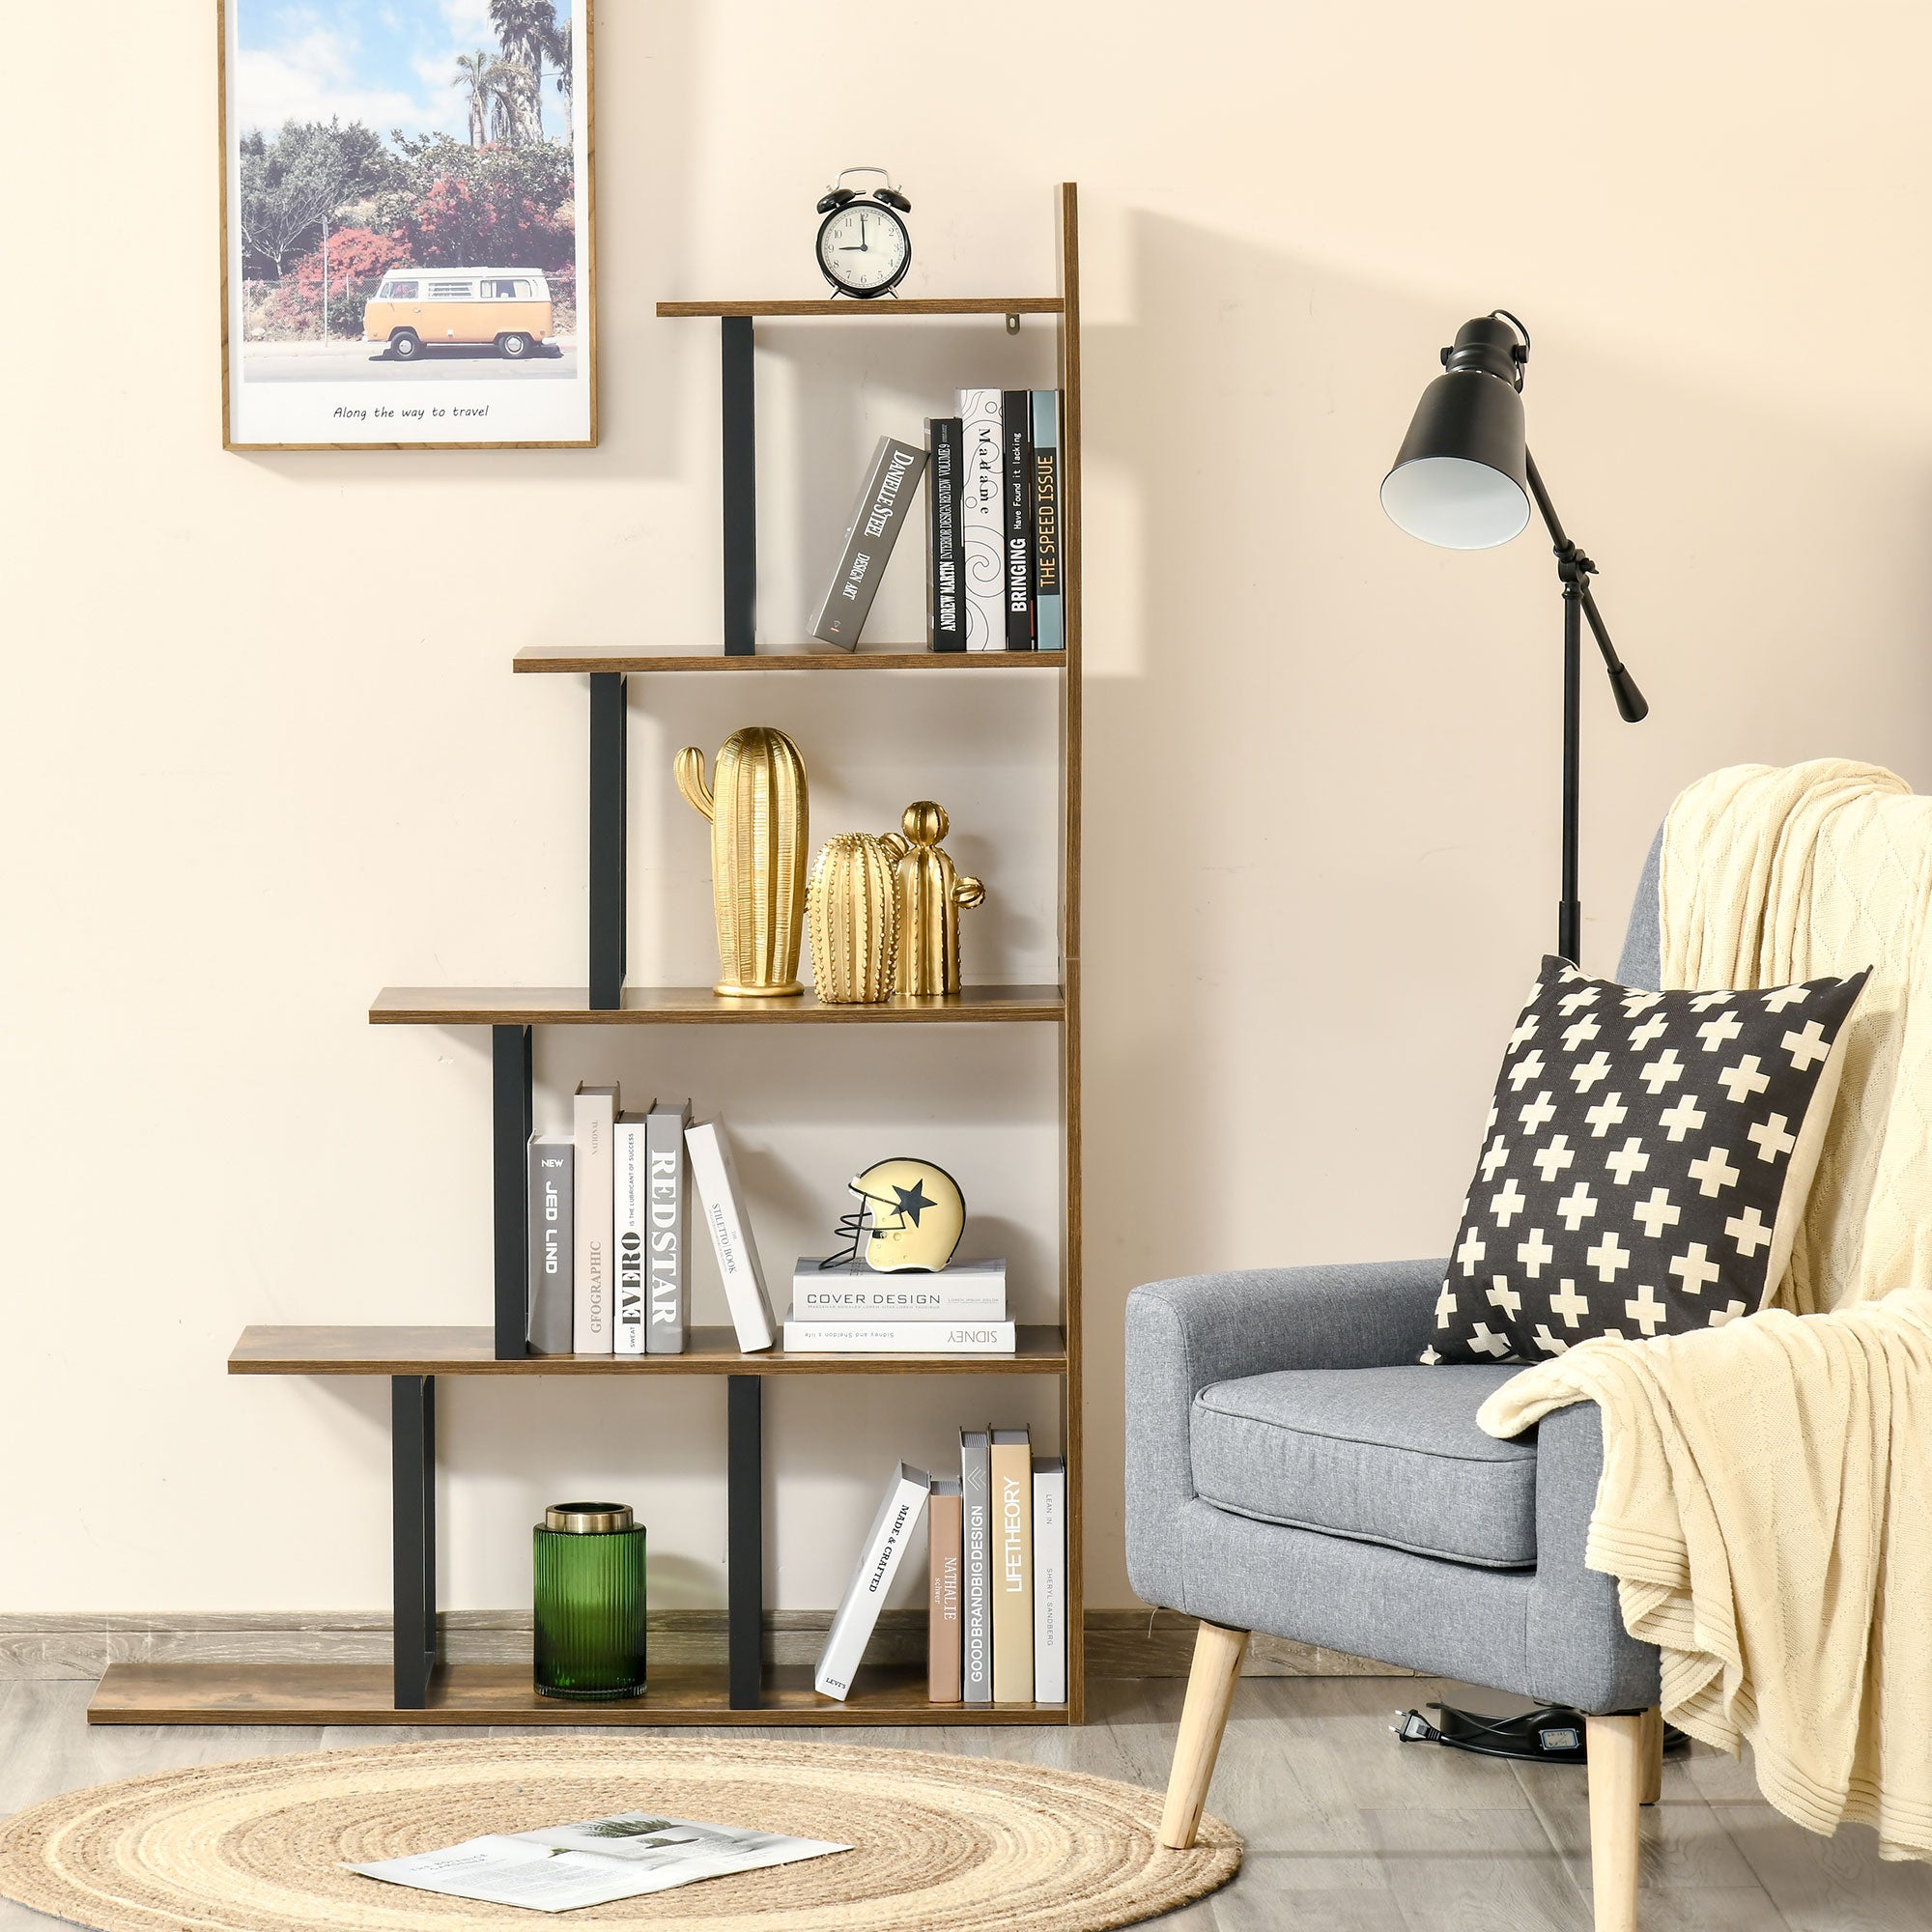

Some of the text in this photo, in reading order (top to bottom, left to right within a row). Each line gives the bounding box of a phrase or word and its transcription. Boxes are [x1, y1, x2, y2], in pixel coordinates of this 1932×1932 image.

[834, 230, 842, 240] 10
[844, 218, 852, 228] 11
[889, 228, 895, 237] 2
[828, 243, 835, 253] 9
[833, 260, 839, 269] 8
[846, 270, 852, 279] 7
[860, 274, 867, 284] 6
[877, 270, 883, 280] 5
[333, 406, 489, 421] Along the way to travel
[938, 448, 952, 477] VOLUME
[979, 428, 991, 515] Madame
[939, 478, 952, 504] REVIEW
[939, 504, 952, 528] DESIGN
[1010, 433, 1028, 612] BRINGING Have Found it lacking
[1037, 456, 1056, 587] THE SPEED ISSUE
[940, 529, 952, 559] INTERIOR
[842, 552, 870, 601] DESIGN ART
[939, 561, 955, 593] MARTIN
[941, 595, 956, 632] ANDREW
[545, 1180, 558, 1273] JED LIND
[652, 1150, 677, 1325] REDSTAR
[621, 1232, 641, 1325] EVERO
[808, 1294, 941, 1304] COVER DESIGN
[947, 1331, 998, 1343] SIDNEY
[971, 1505, 983, 1560] DESIGN
[1003, 1475, 1023, 1592] LIFETHEORY
[869, 1504, 910, 1593] MADE & CRAFTED
[944, 1556, 957, 1621] NATHALIE
[971, 1638, 983, 1683] GOOD
